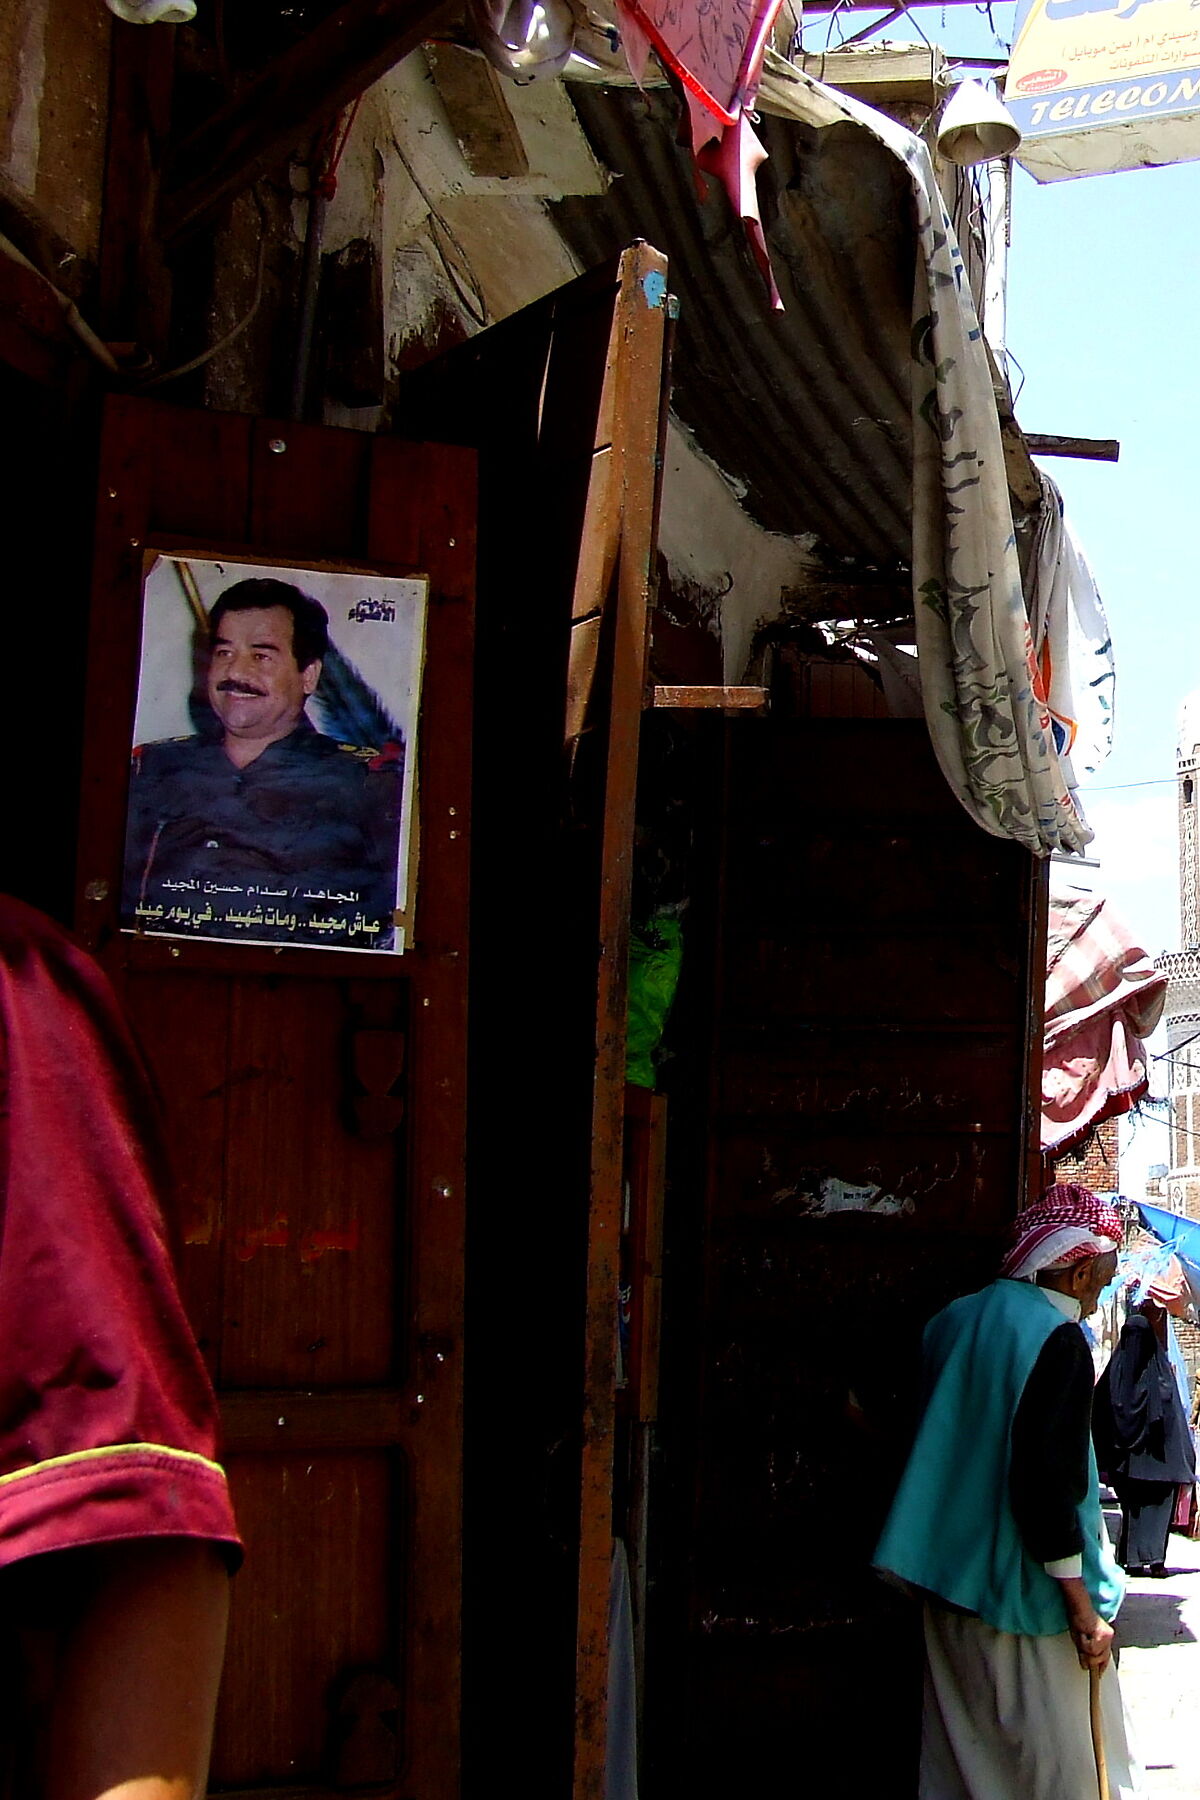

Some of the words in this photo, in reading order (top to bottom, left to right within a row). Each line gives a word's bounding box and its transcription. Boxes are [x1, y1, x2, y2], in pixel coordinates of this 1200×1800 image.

[161, 878, 199, 892] المجيد
[203, 880, 243, 894] حسين
[247, 884, 288, 898] صدام
[303, 886, 359, 902] المجاهد
[135, 900, 163, 922] عيد
[165, 906, 192, 925] يوم
[192, 901, 213, 928] في
[264, 908, 296, 931] ومات
[348, 911, 380, 936] عاش
